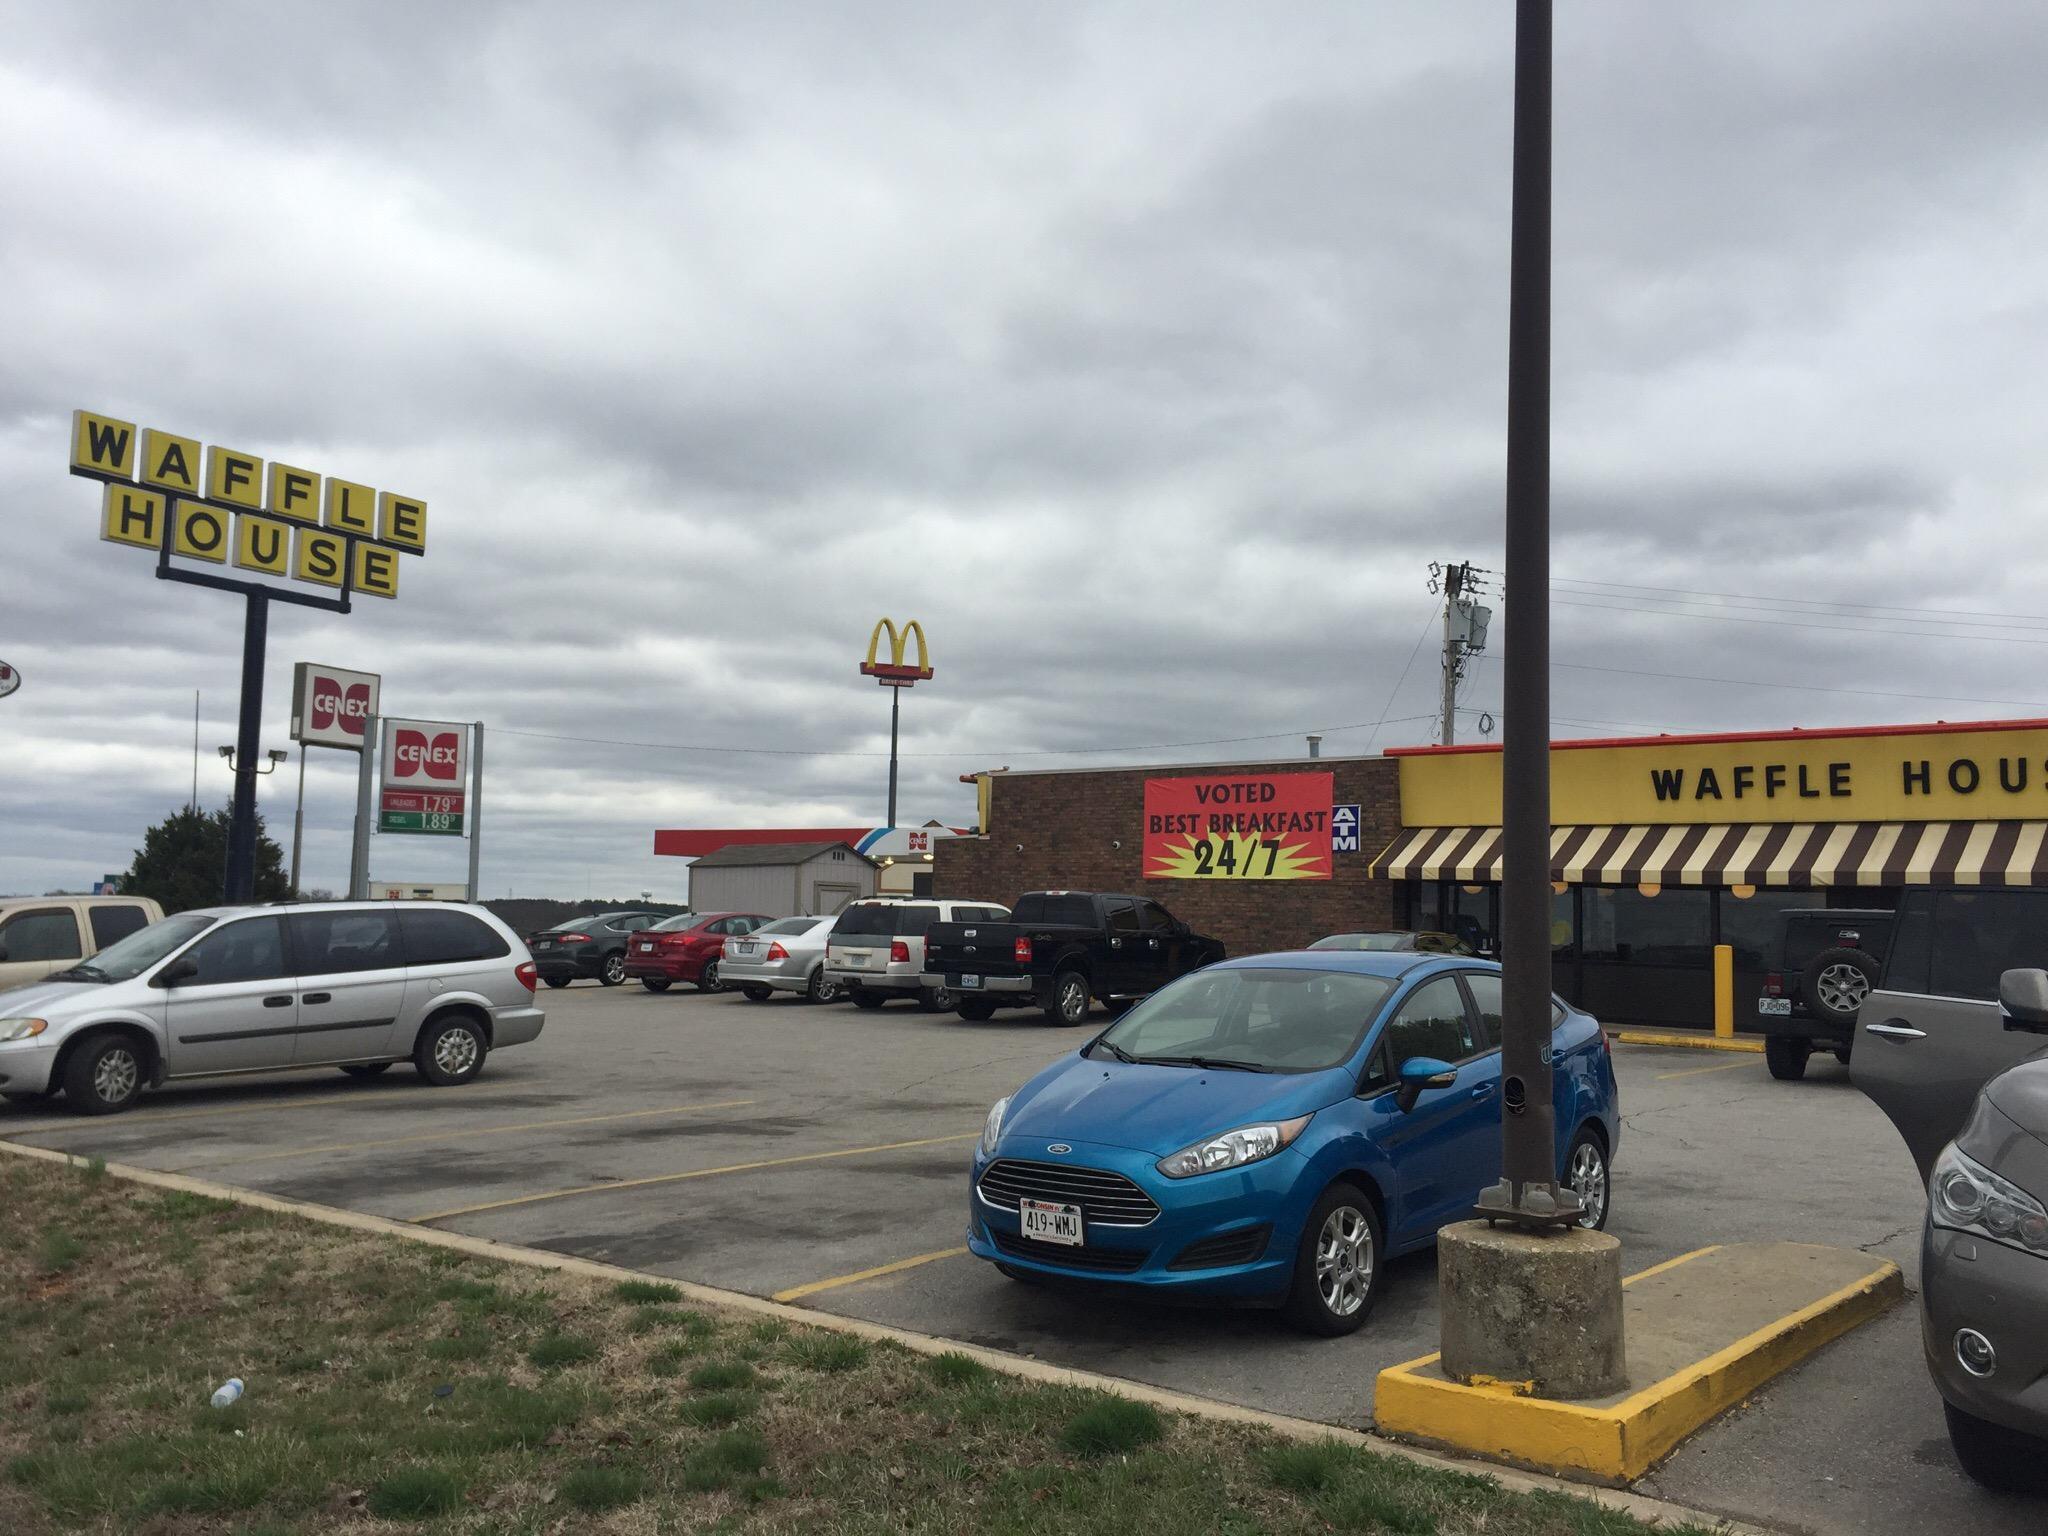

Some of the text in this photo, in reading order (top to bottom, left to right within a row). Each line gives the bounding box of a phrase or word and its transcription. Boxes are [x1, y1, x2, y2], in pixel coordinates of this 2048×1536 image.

[88, 420, 420, 541] WAFFLE
[119, 494, 392, 589] HOUSE
[313, 694, 367, 717] CENEX
[397, 745, 456, 764] CENEX
[1195, 782, 1276, 804] VOTED
[1650, 757, 2048, 801] WAFFLE HOU
[1150, 811, 1328, 834] BEST BREAKFAST
[1332, 807, 1357, 851] ATM
[1194, 838, 1280, 876] 24/7
[1026, 1211, 1077, 1236] 419-WMJ
